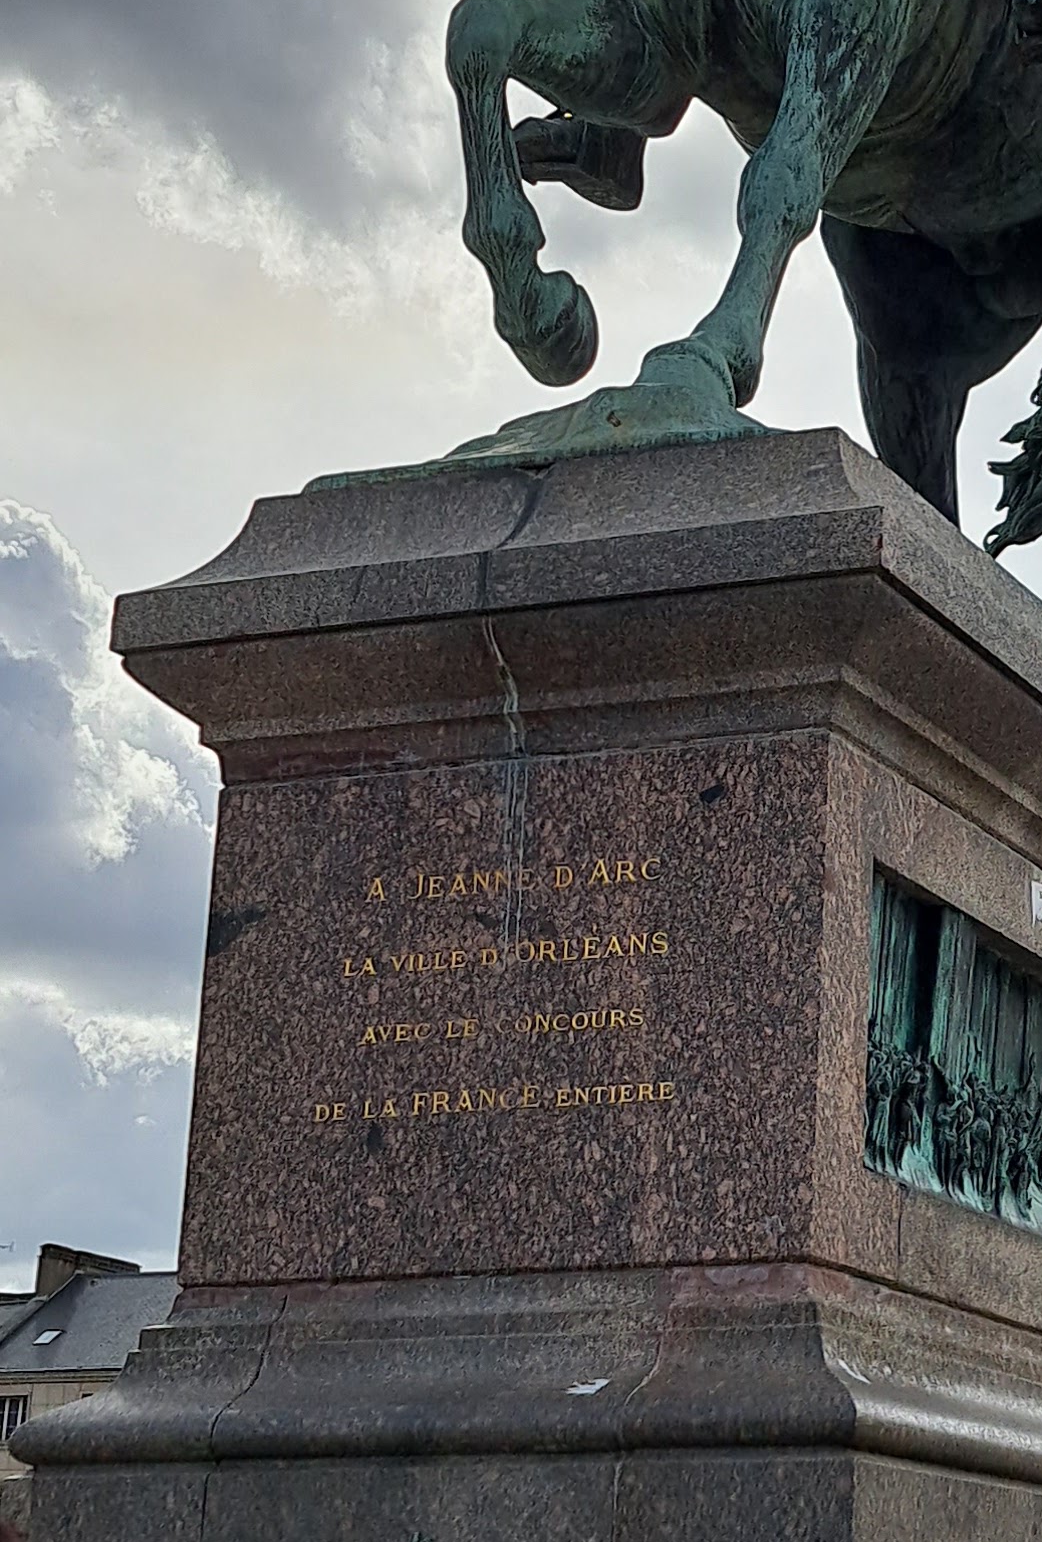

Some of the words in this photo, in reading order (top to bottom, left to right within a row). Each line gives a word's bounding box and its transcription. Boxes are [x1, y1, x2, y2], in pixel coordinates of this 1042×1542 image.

[366, 877, 386, 903] A
[409, 865, 536, 900] JEANNE
[343, 956, 376, 977] LA
[391, 950, 467, 972] VILLE
[481, 924, 670, 966] DORLÉANS
[358, 1022, 432, 1046] AVEC
[446, 1018, 480, 1039] LE
[498, 1007, 645, 1034] CONCOURS
[314, 1103, 346, 1122] DE
[362, 1098, 398, 1119] LA
[412, 1084, 540, 1115] FRANCE
